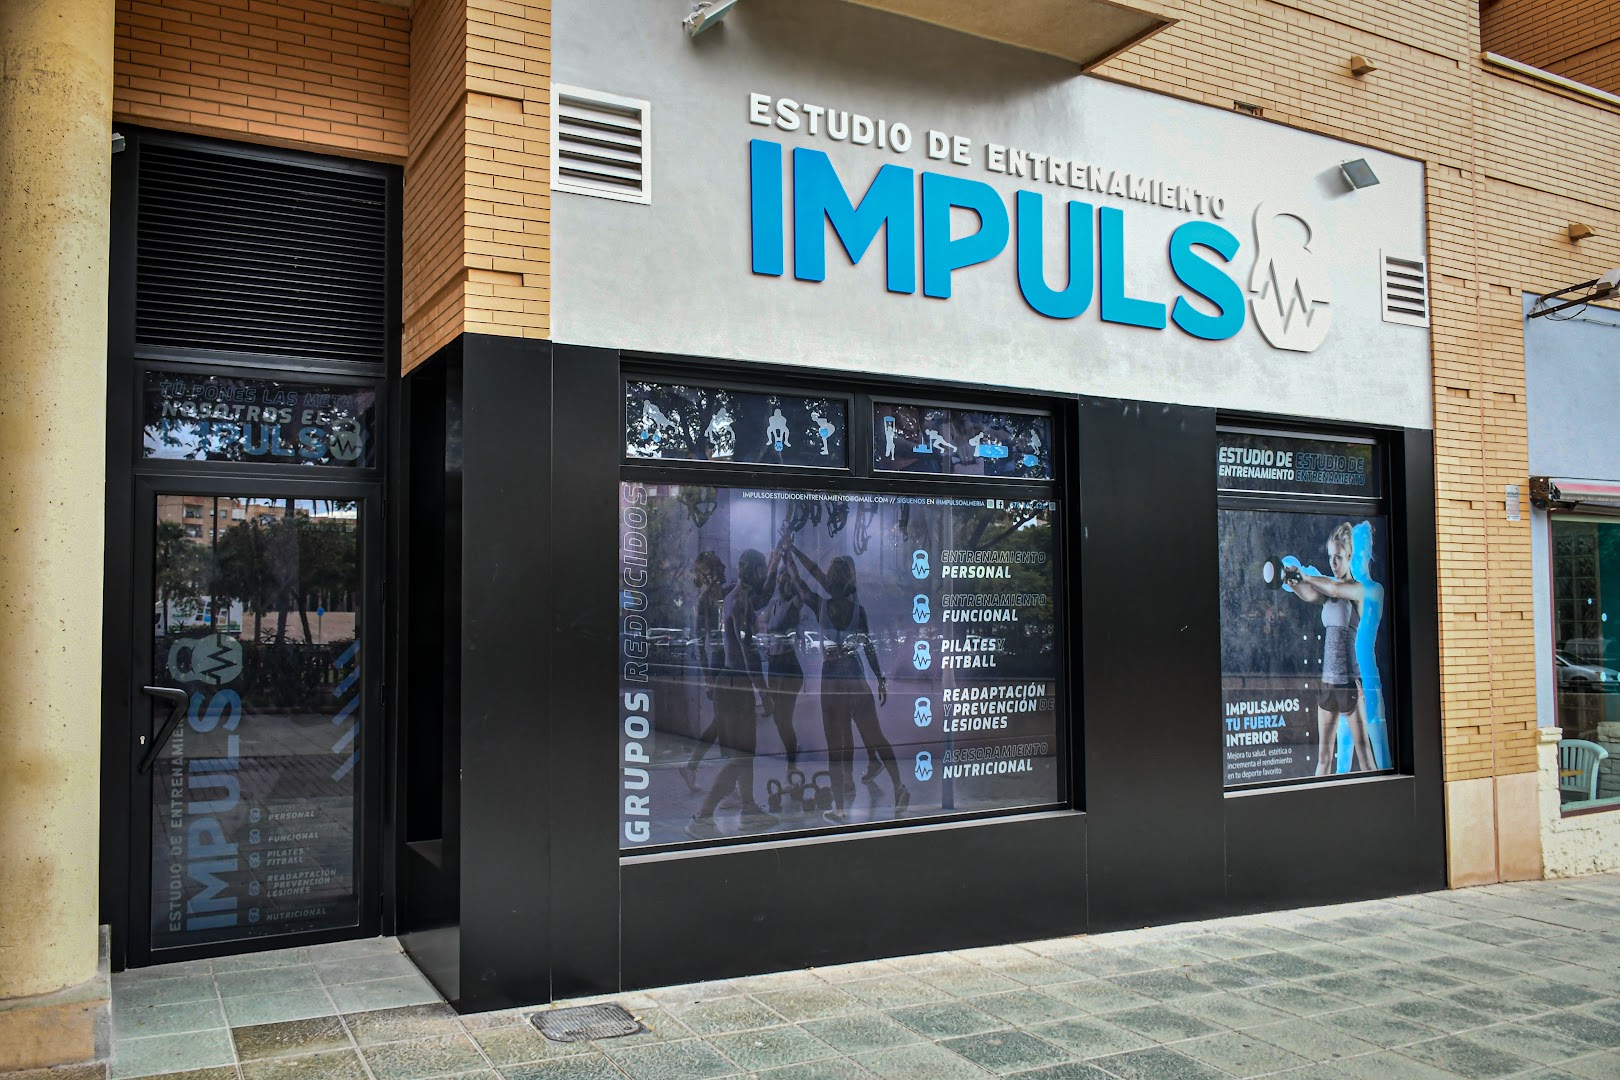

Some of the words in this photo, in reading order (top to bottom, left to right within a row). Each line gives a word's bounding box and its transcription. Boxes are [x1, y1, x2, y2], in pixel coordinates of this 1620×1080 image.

[749, 92, 912, 153] ESTUDIO
[927, 129, 972, 166] DE
[986, 143, 1226, 219] ENTRENAMIENTO
[750, 139, 1246, 341] IMPULS
[263, 389, 299, 406] LAS
[162, 400, 293, 424] NOSOTROS
[1218, 447, 1273, 465] ESTUDIO
[1276, 452, 1293, 467] DE
[1295, 453, 1347, 472] ESTUDIO
[1348, 457, 1364, 473] DE
[1218, 465, 1294, 481] ENTRENAMIENTO
[1295, 469, 1365, 485] ENTRENAMIENTO
[941, 550, 1046, 564] ENTRENAMIENTO
[941, 565, 1011, 579] PERSONAL
[623, 484, 649, 683] REDUCIDOS
[942, 594, 1047, 607] ENTRENAMIENTO
[942, 608, 1018, 622] FUNCIONAL
[941, 638, 997, 652] PILATES
[941, 655, 996, 669] FITBALL
[943, 682, 1046, 702] READAPTACIÓN
[943, 704, 952, 717] Y
[953, 698, 1037, 716] PREVENCIÓN
[1039, 698, 1055, 711] DE
[1226, 698, 1300, 716] IMPULSAMOS
[943, 716, 1008, 732] LESIONES
[1226, 717, 1241, 731] TU
[1243, 714, 1286, 730] FUERZA
[1226, 730, 1279, 747] INTERIOR
[943, 742, 1048, 763] ASESORAMIENTO
[1227, 752, 1245, 760] Mejora
[1269, 747, 1287, 756] estética
[624, 692, 650, 843] GRUPOS
[943, 759, 1033, 779] NUTRICIONAL
[1227, 760, 1256, 769] incrementa
[1257, 759, 1261, 767] el
[1262, 757, 1292, 766] rendimiento
[1235, 771, 1241, 779] tu
[1242, 770, 1262, 779] deporte
[1262, 767, 1282, 776] favorito
[186, 688, 242, 931] IMPULS
[268, 811, 315, 821] PERSONAL
[170, 835, 183, 856] DE
[268, 832, 319, 843] FUNCIONAL
[267, 847, 304, 857] PILATES
[267, 857, 303, 866] FITBALL
[268, 868, 337, 882] READAPTACIÓN
[169, 863, 182, 932] ESTUDIO
[267, 886, 310, 897] LESIONES
[267, 907, 326, 921] NUTRICIONAL
